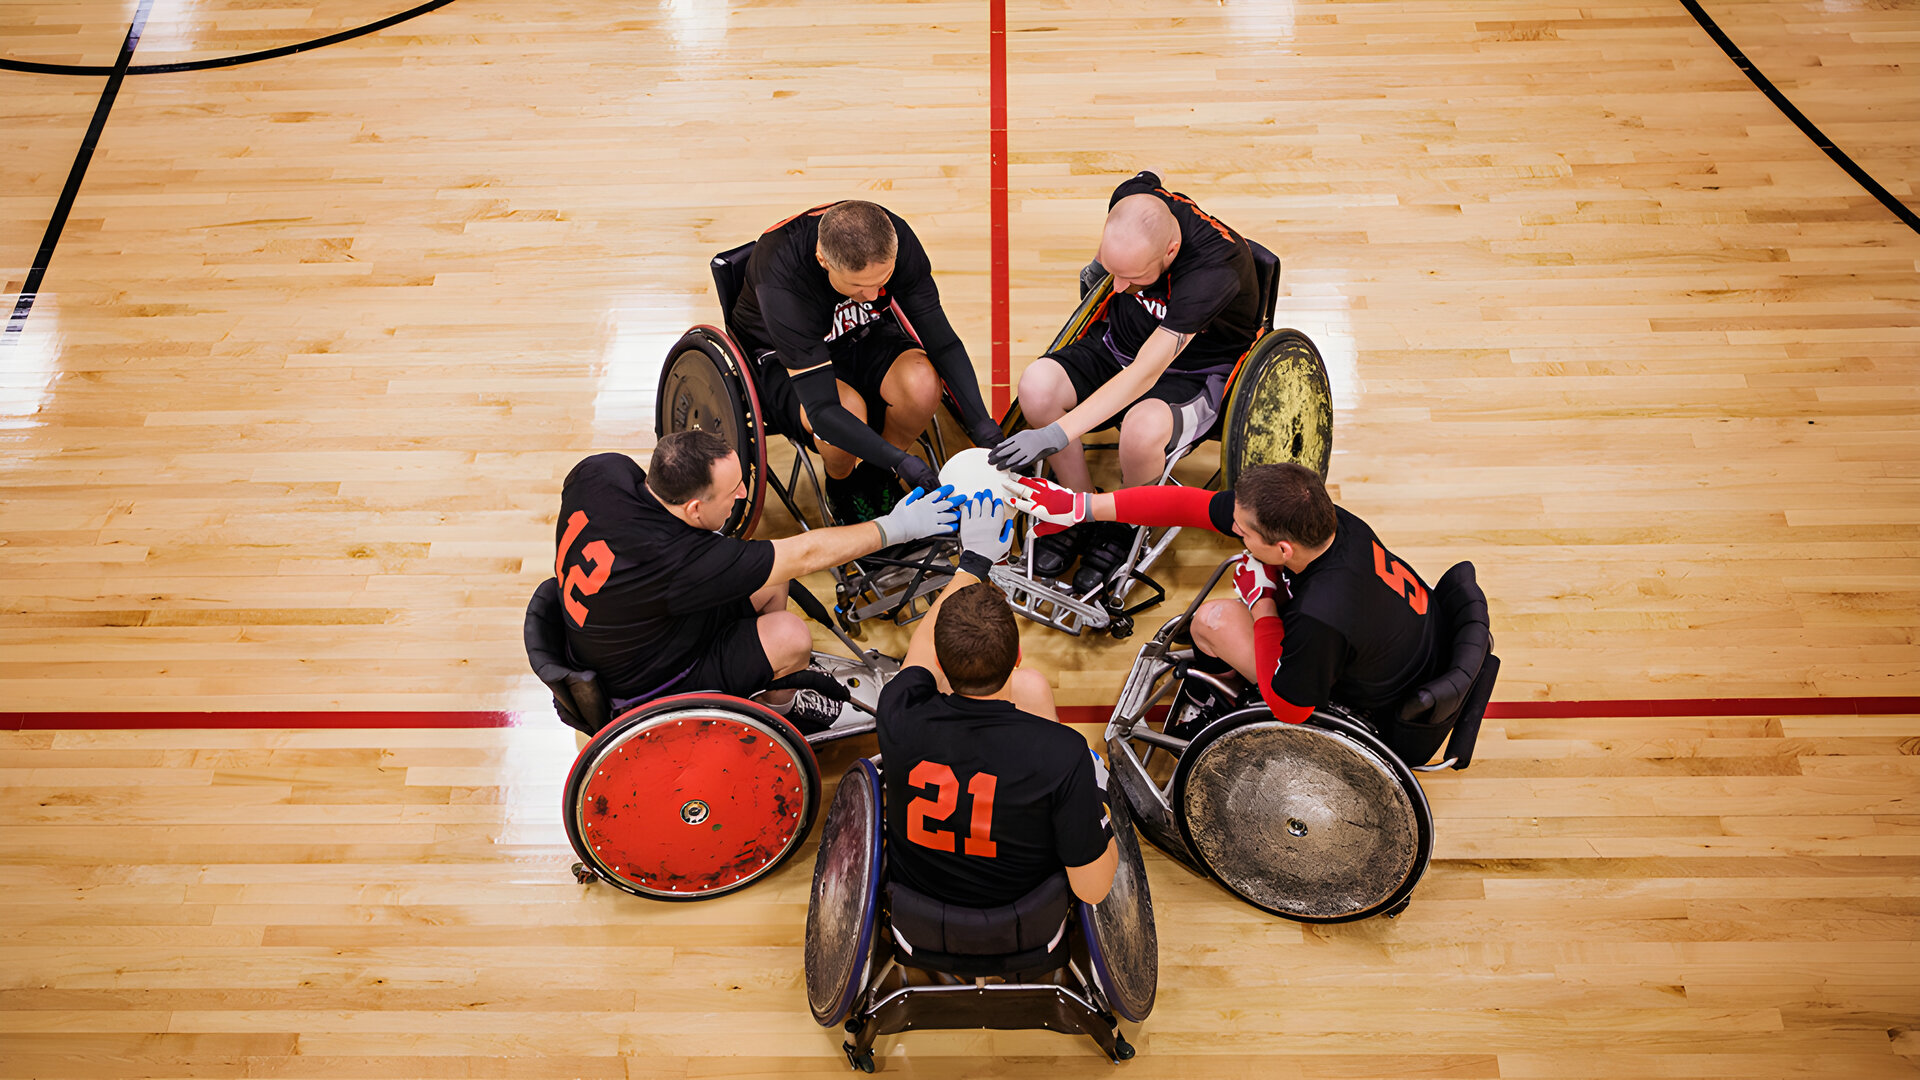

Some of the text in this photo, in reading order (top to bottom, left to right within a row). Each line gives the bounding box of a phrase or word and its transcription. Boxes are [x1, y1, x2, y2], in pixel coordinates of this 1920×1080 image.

[555, 510, 615, 628] 12
[1371, 540, 1429, 615] 5
[907, 760, 997, 858] 21
